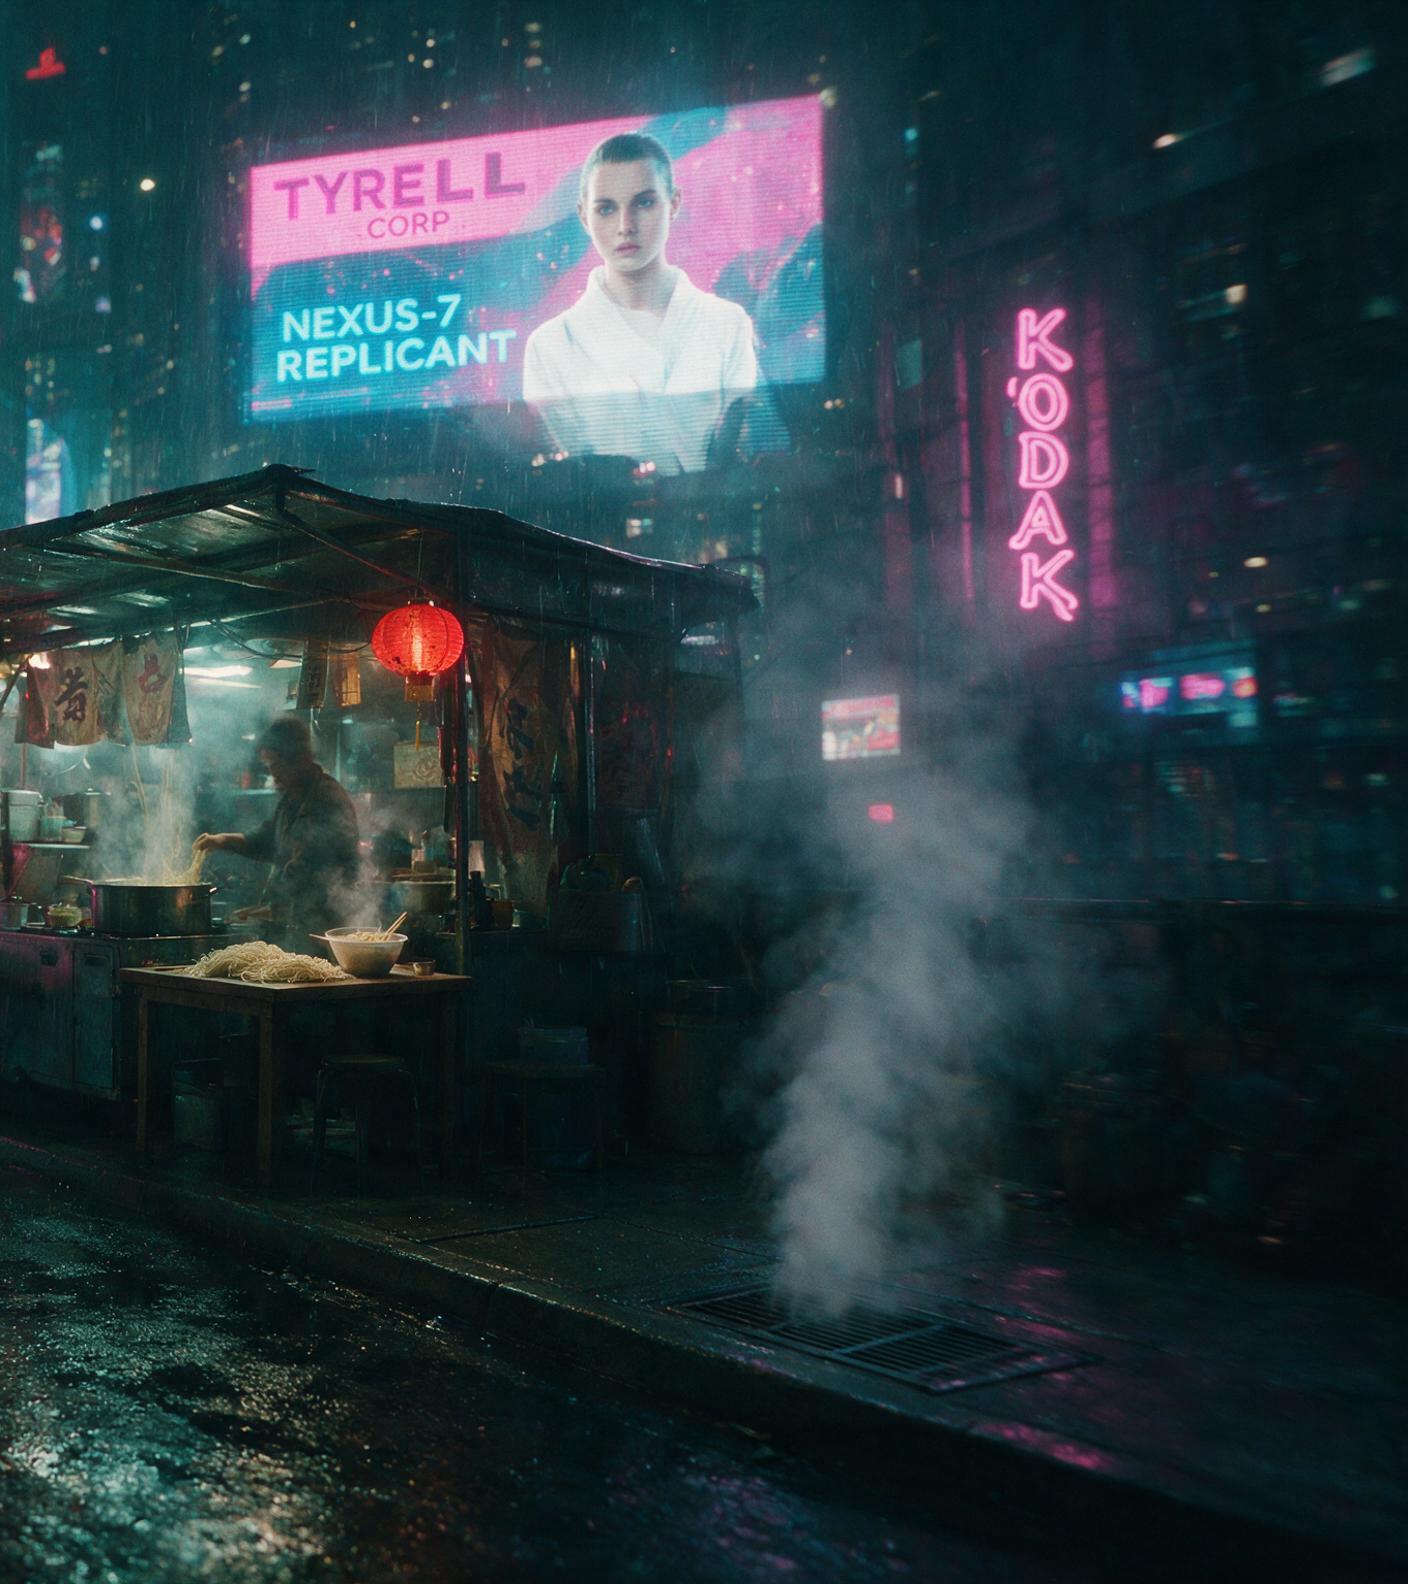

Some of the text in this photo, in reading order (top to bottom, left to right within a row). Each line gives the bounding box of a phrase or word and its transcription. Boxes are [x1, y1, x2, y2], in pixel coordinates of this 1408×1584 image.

[273, 151, 526, 221] TYRELL
[367, 210, 450, 239] CORP
[282, 293, 462, 343] NEXUS-7
[276, 329, 518, 383] REPLICANT
